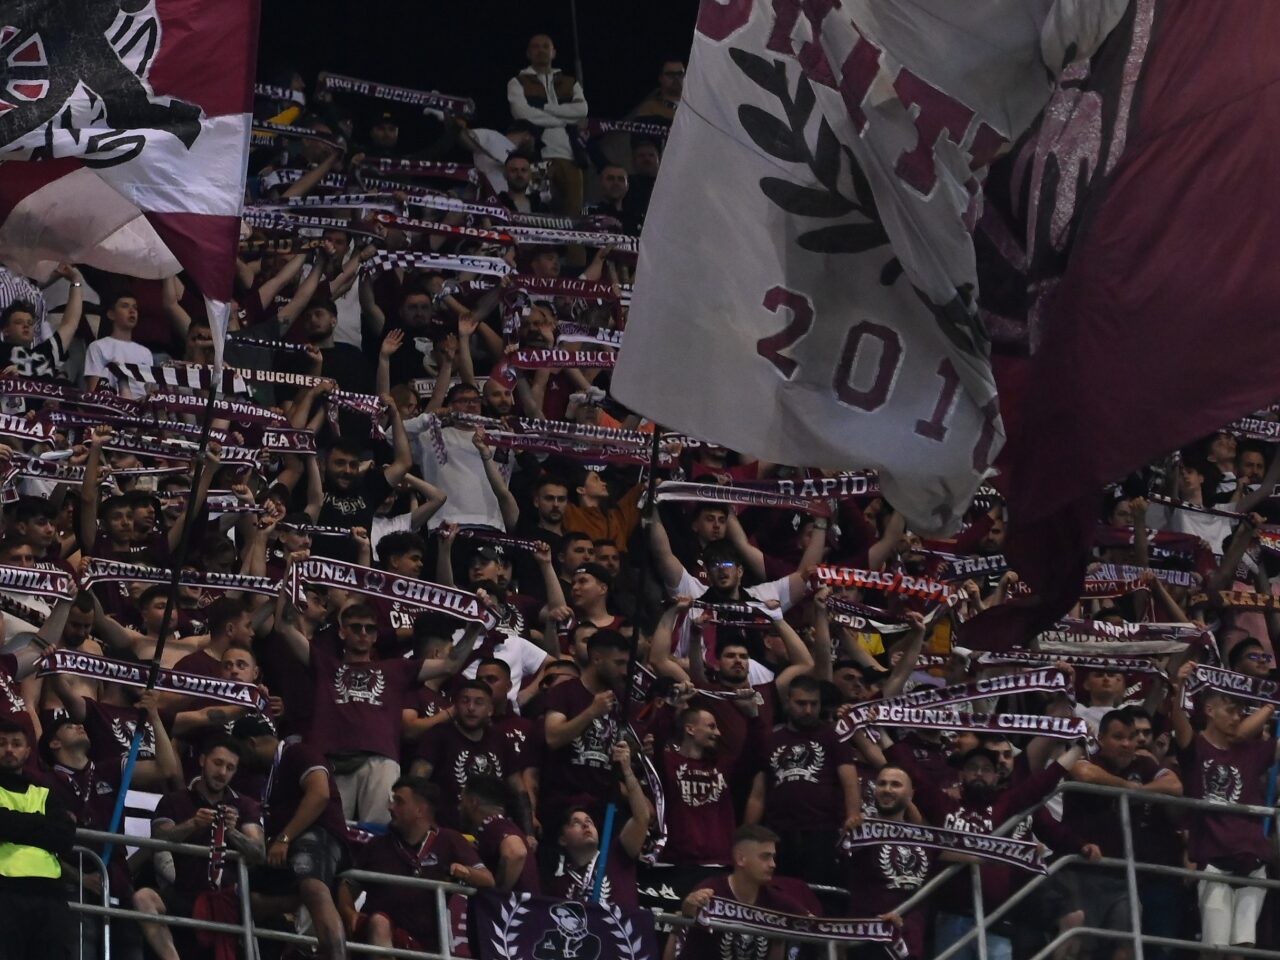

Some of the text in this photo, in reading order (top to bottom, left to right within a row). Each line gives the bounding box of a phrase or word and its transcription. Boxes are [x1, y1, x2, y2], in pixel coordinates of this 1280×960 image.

[517, 349, 617, 364] RAPID BUCU
[256, 368, 321, 388] BUCURES
[518, 416, 571, 435] RAPID
[778, 475, 869, 498] RAPID
[87, 562, 284, 592] LEGIUNEA CHITILA
[815, 567, 894, 587] ULTRAS
[392, 578, 480, 616] CHITILA
[54, 652, 253, 702] LEGIUNEA CHITILA
[976, 671, 1066, 693] CHITILA
[998, 713, 1089, 734] CHITILA
[851, 822, 1037, 865] LEGIUNEA CHITILA
[703, 898, 788, 929] LEGIUNEA
